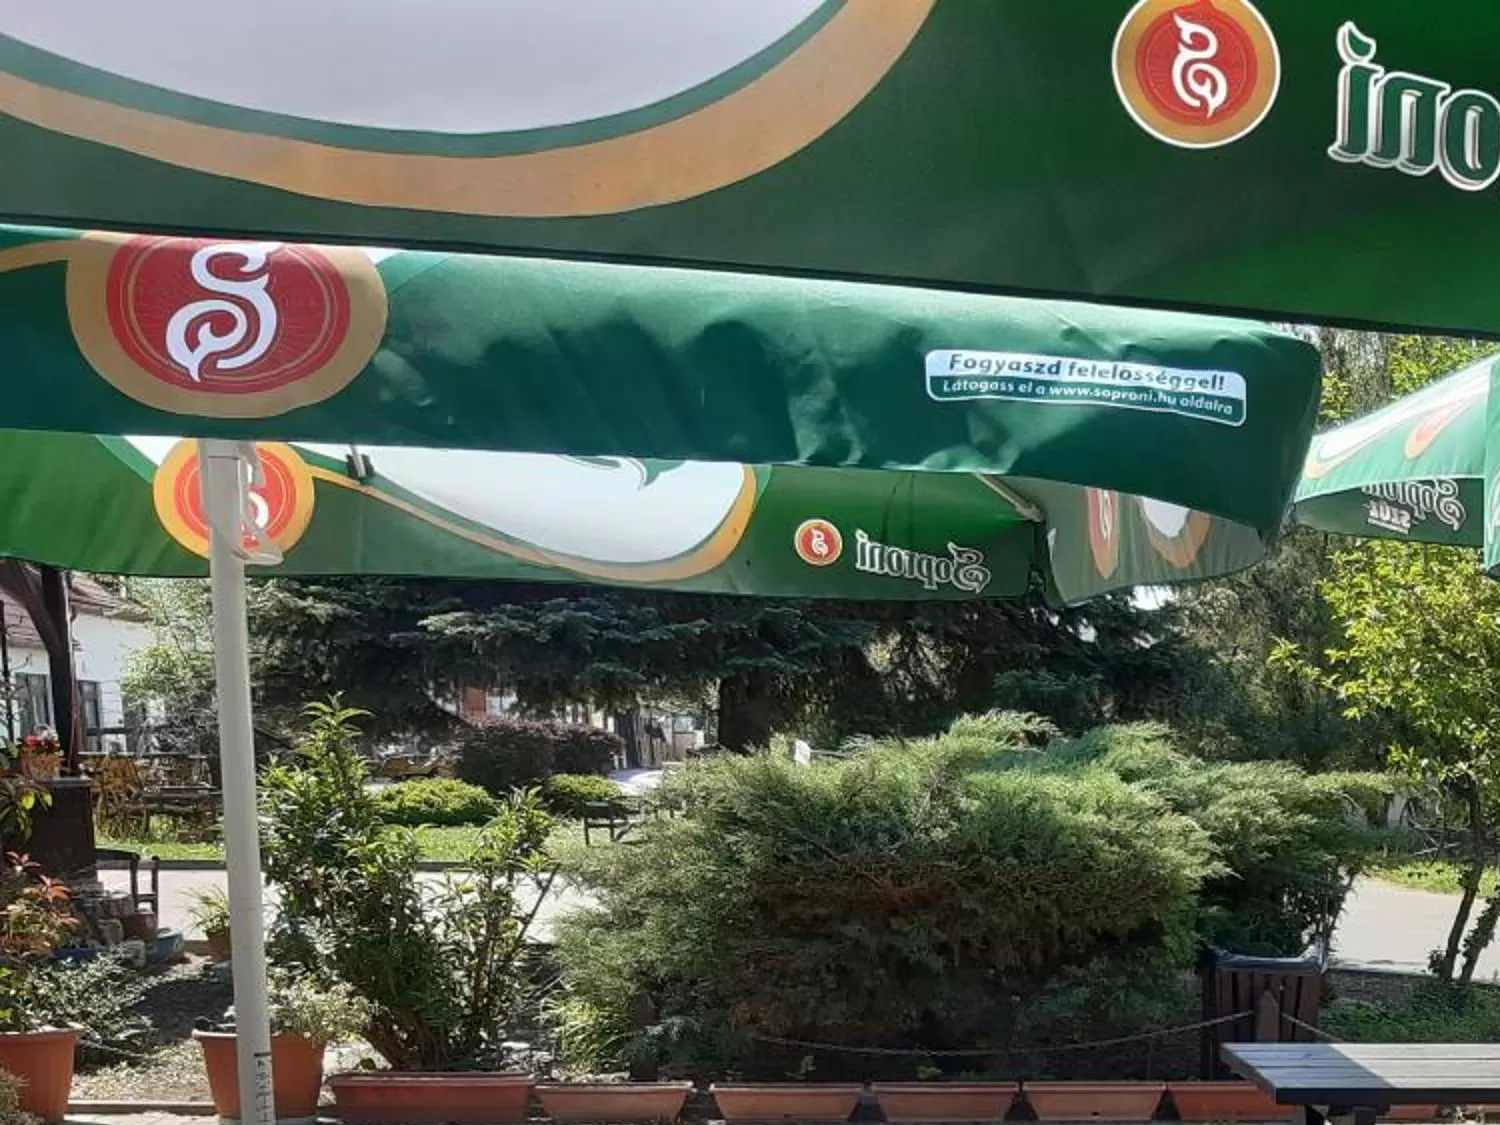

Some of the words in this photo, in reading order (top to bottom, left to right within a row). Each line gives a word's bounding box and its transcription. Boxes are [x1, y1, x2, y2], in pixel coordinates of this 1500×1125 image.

[949, 353, 1061, 375] Fogyaszd
[943, 379, 1016, 393] Látogass
[1048, 385, 1177, 404] www.soproni.hu
[1179, 396, 1233, 415] oldalra
